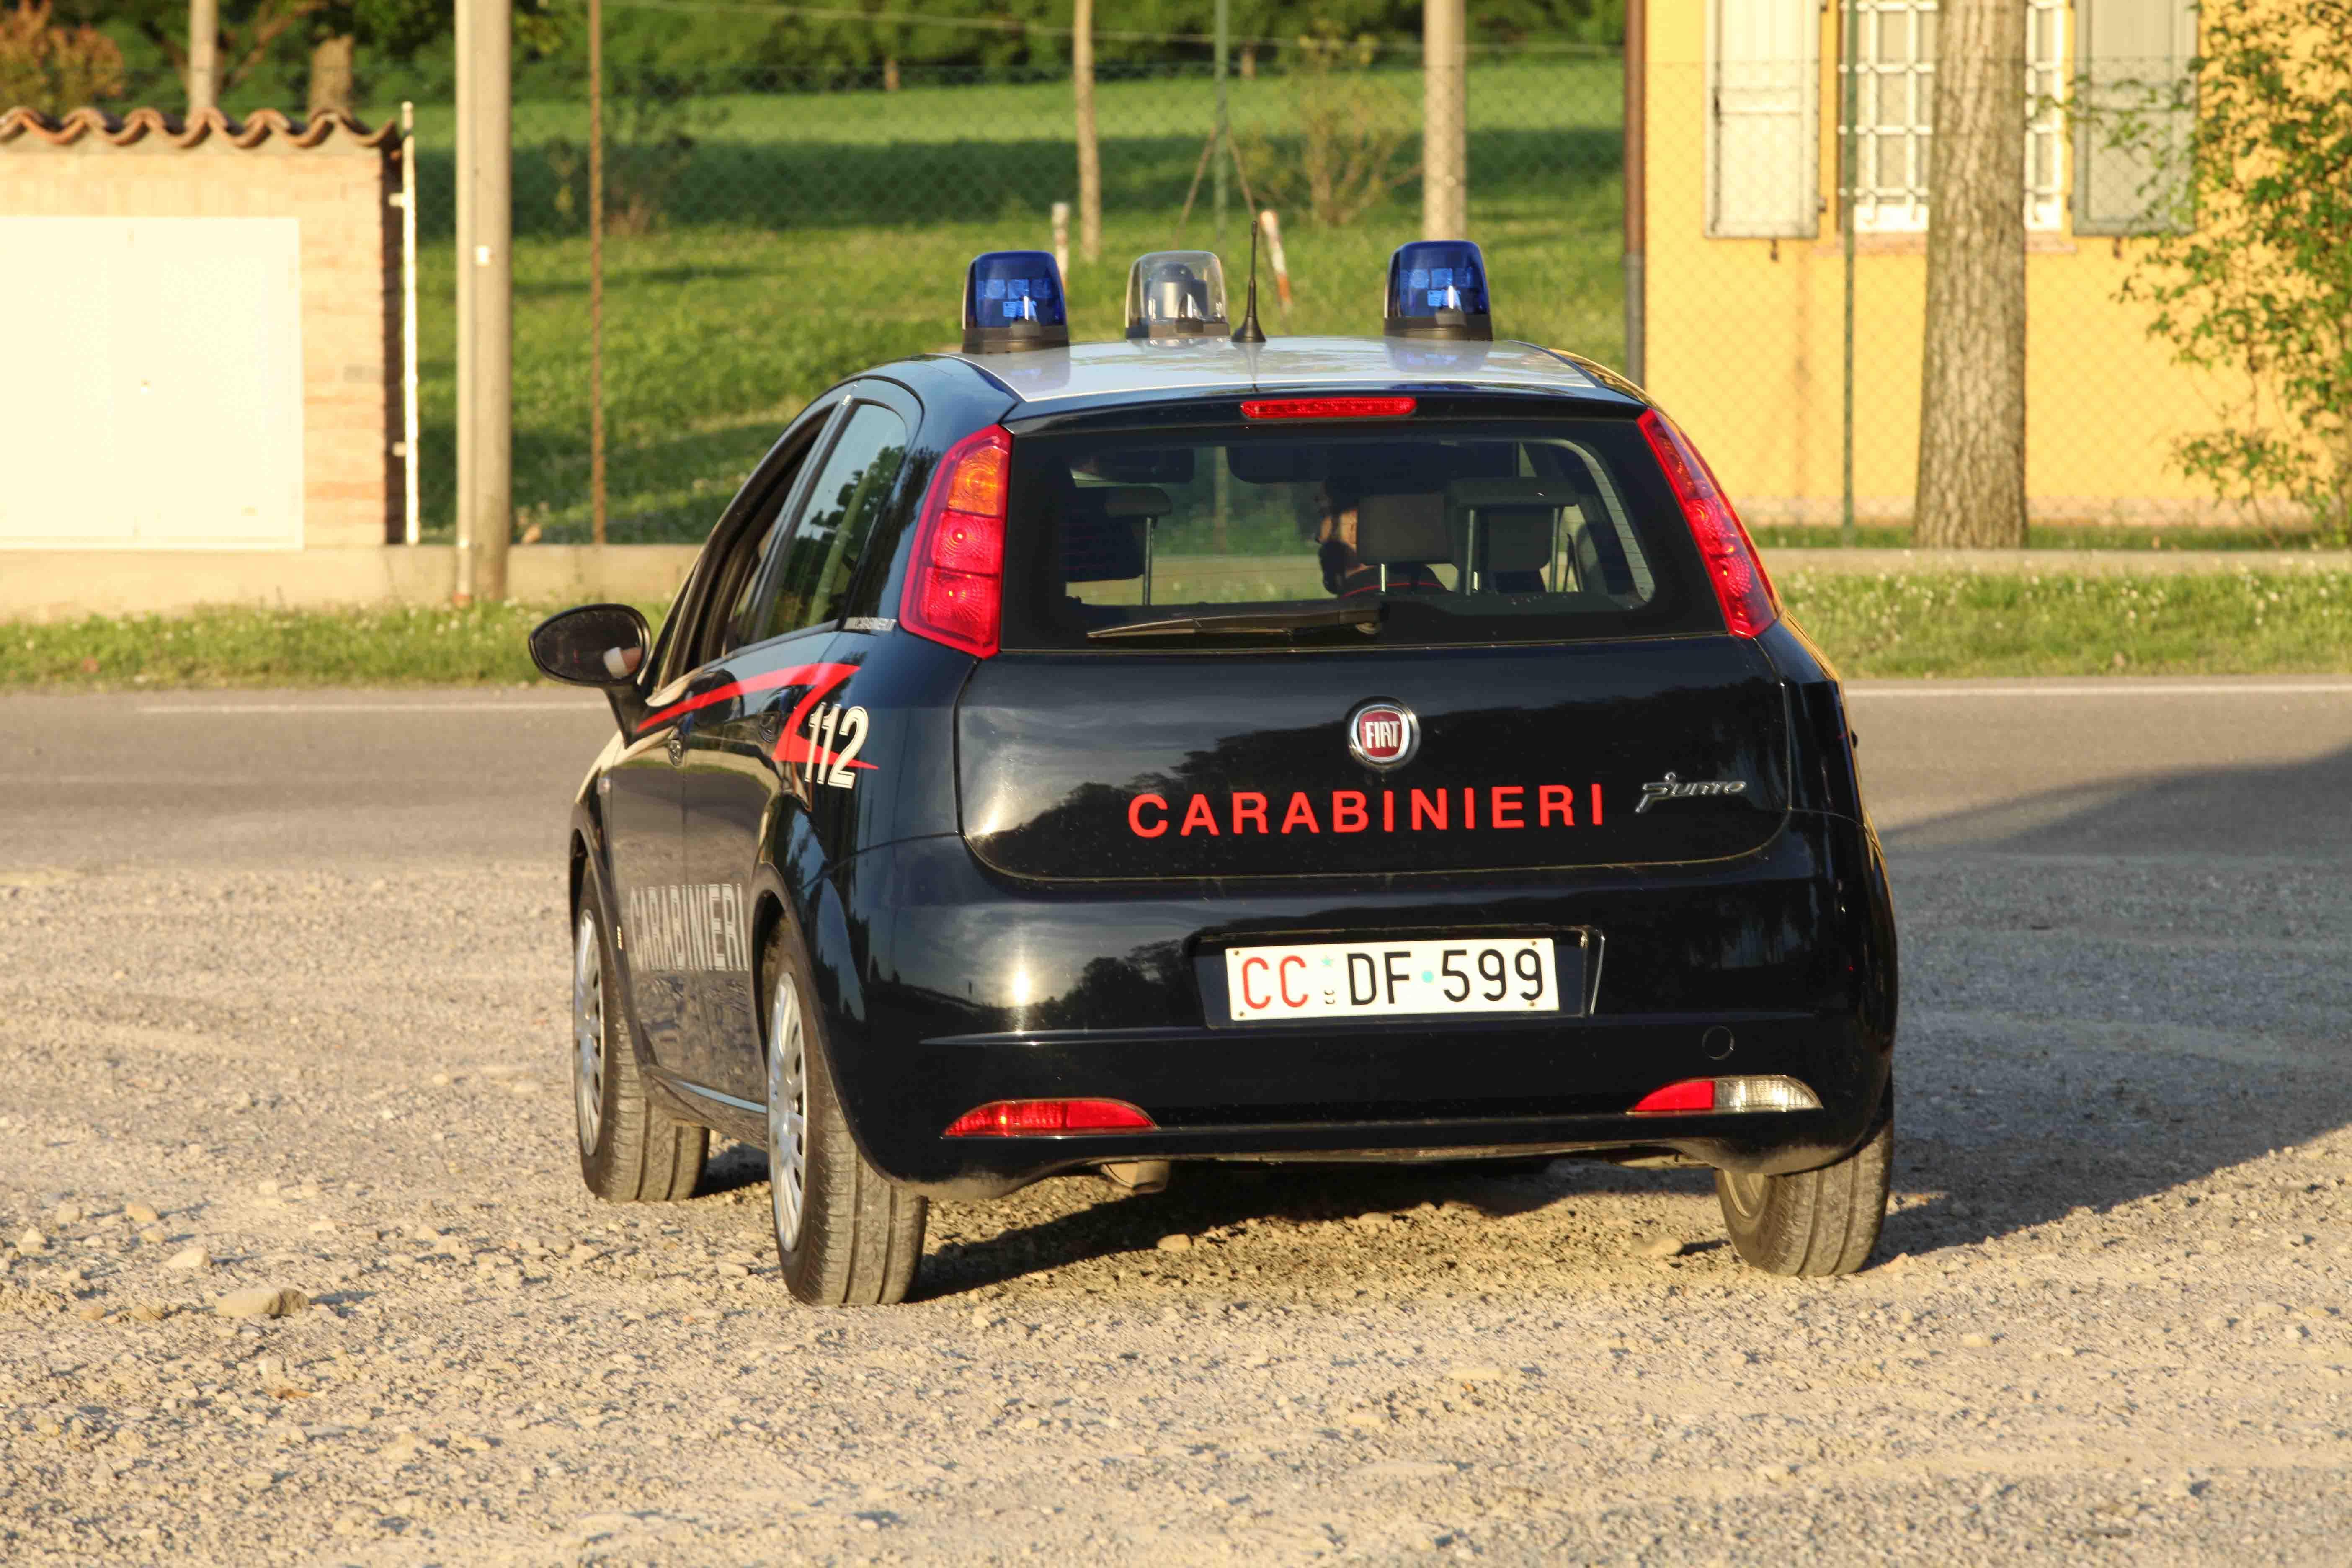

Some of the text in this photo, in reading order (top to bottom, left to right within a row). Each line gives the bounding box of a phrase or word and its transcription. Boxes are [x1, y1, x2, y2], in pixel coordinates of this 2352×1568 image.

[804, 702, 869, 789] 112
[1365, 721, 1401, 748] FIAT
[1128, 784, 1603, 838] CARABINIERI
[630, 883, 749, 971] CARABINIERI
[1242, 948, 1544, 1009] CC DF 599
